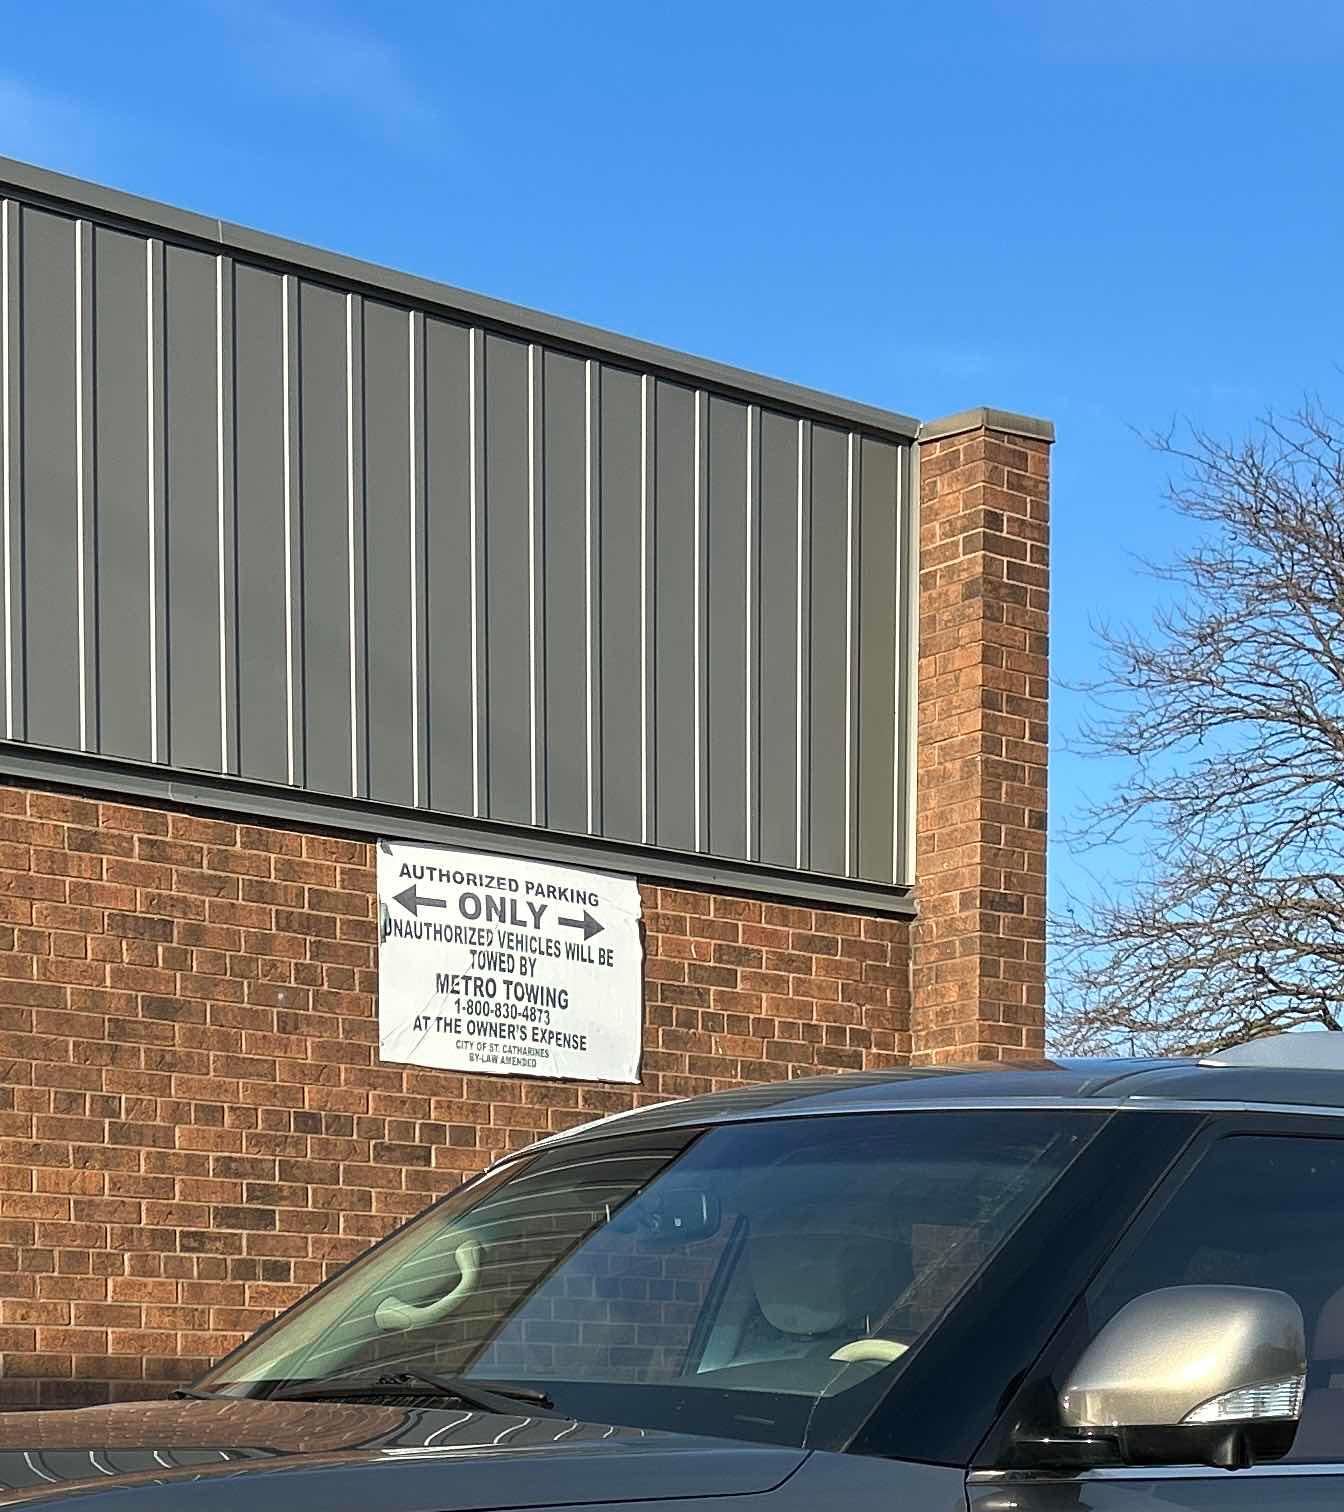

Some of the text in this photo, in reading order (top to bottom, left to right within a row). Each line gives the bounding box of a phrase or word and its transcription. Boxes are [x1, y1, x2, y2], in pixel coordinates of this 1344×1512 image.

[399, 862, 599, 907] AUTHORIZED PARKING
[458, 891, 548, 930] ONLY
[384, 918, 614, 968] UNAUTHORIZED VEHICLES WILL BE
[469, 949, 537, 978] TOWED BY
[436, 973, 569, 1010] METRO TOWING
[454, 998, 551, 1026] 1-800-830-4873
[413, 1015, 588, 1051] AT THE OWNER'S EXPENSE
[455, 1039, 474, 1050] CITY
[476, 1041, 487, 1051] OF
